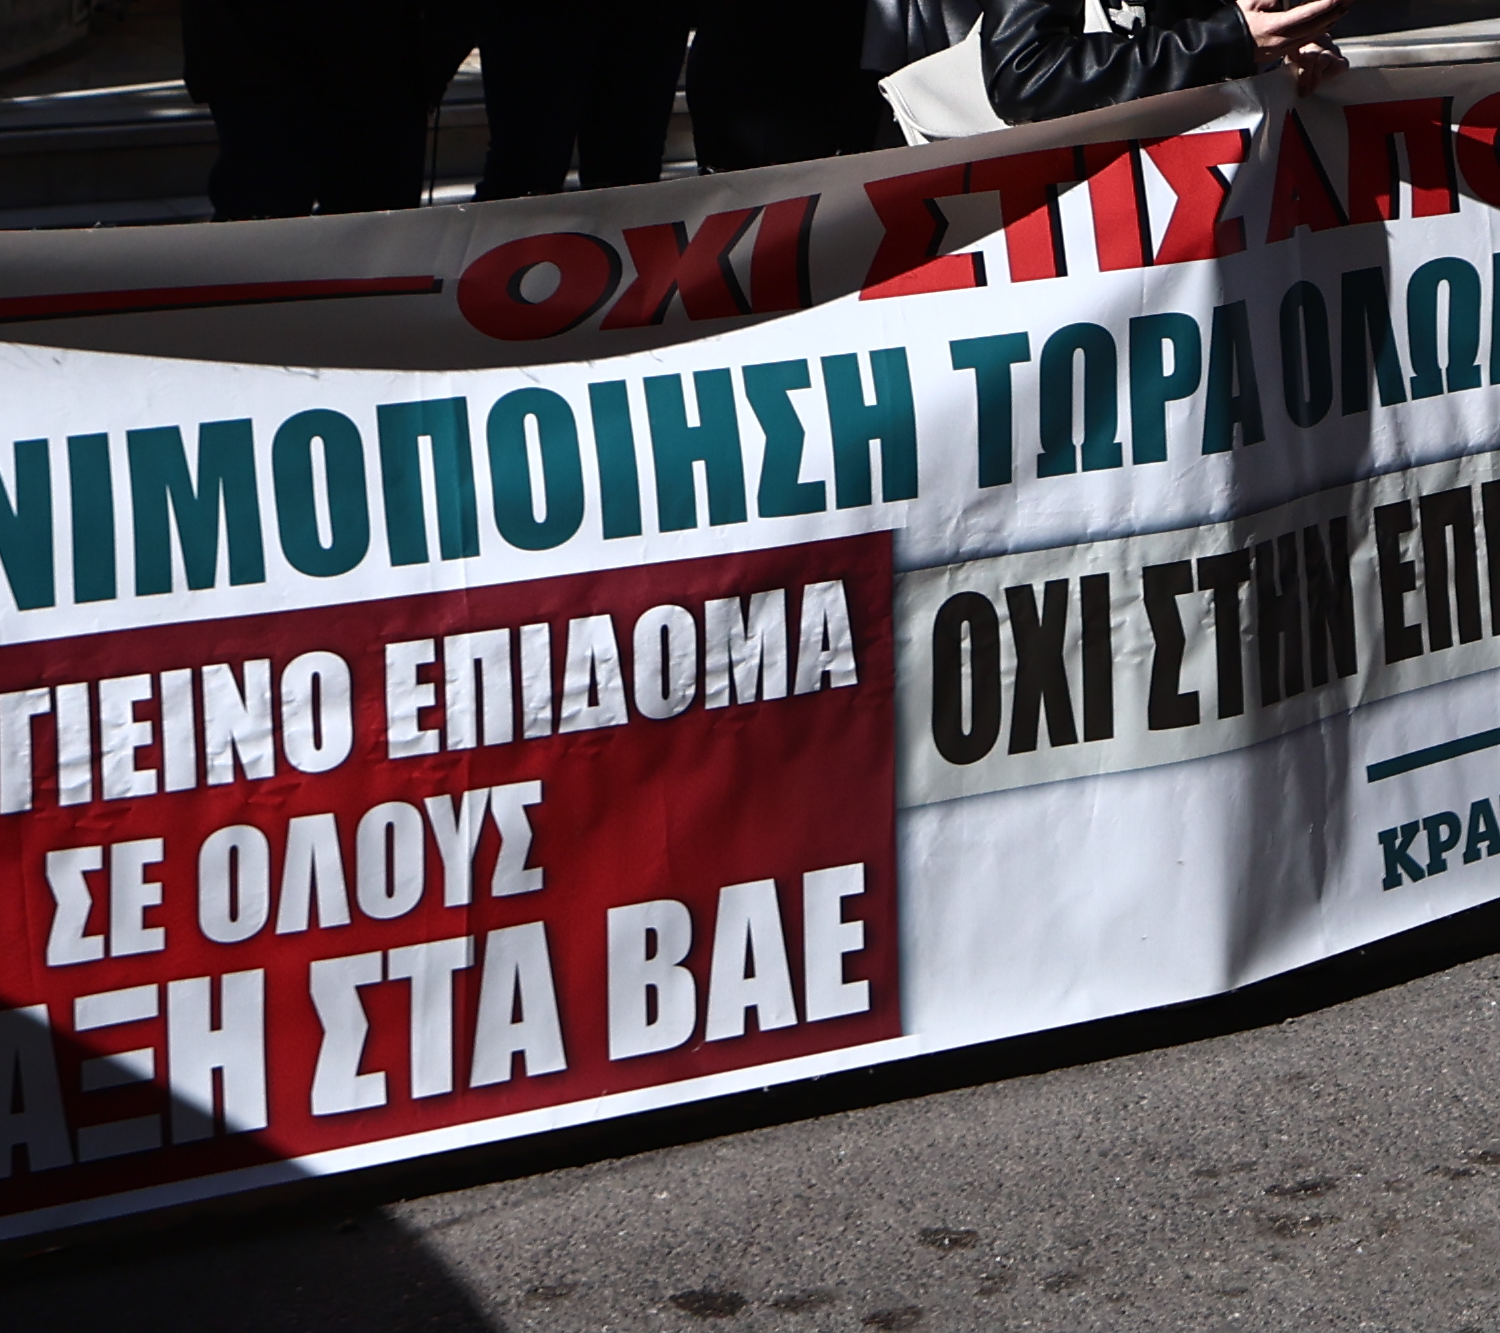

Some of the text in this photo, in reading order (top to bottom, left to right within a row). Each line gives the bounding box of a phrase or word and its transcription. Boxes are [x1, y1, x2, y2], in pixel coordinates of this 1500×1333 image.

[457, 193, 822, 341] ΟΧΙ
[859, 129, 1252, 302] ΣΤΙΣ
[949, 299, 1267, 489] ΤΩΡΑ
[385, 577, 858, 764] ΕΠΙΔΟΜΑ
[932, 574, 1114, 766] ΟΧΙ
[1142, 514, 1358, 730] ΣΤΗΝ
[43, 778, 546, 970] ΣΕ ΟΛΟΥΣ
[308, 921, 569, 1119] ΣΤΑ
[605, 861, 873, 1063] ΒΑΕ
